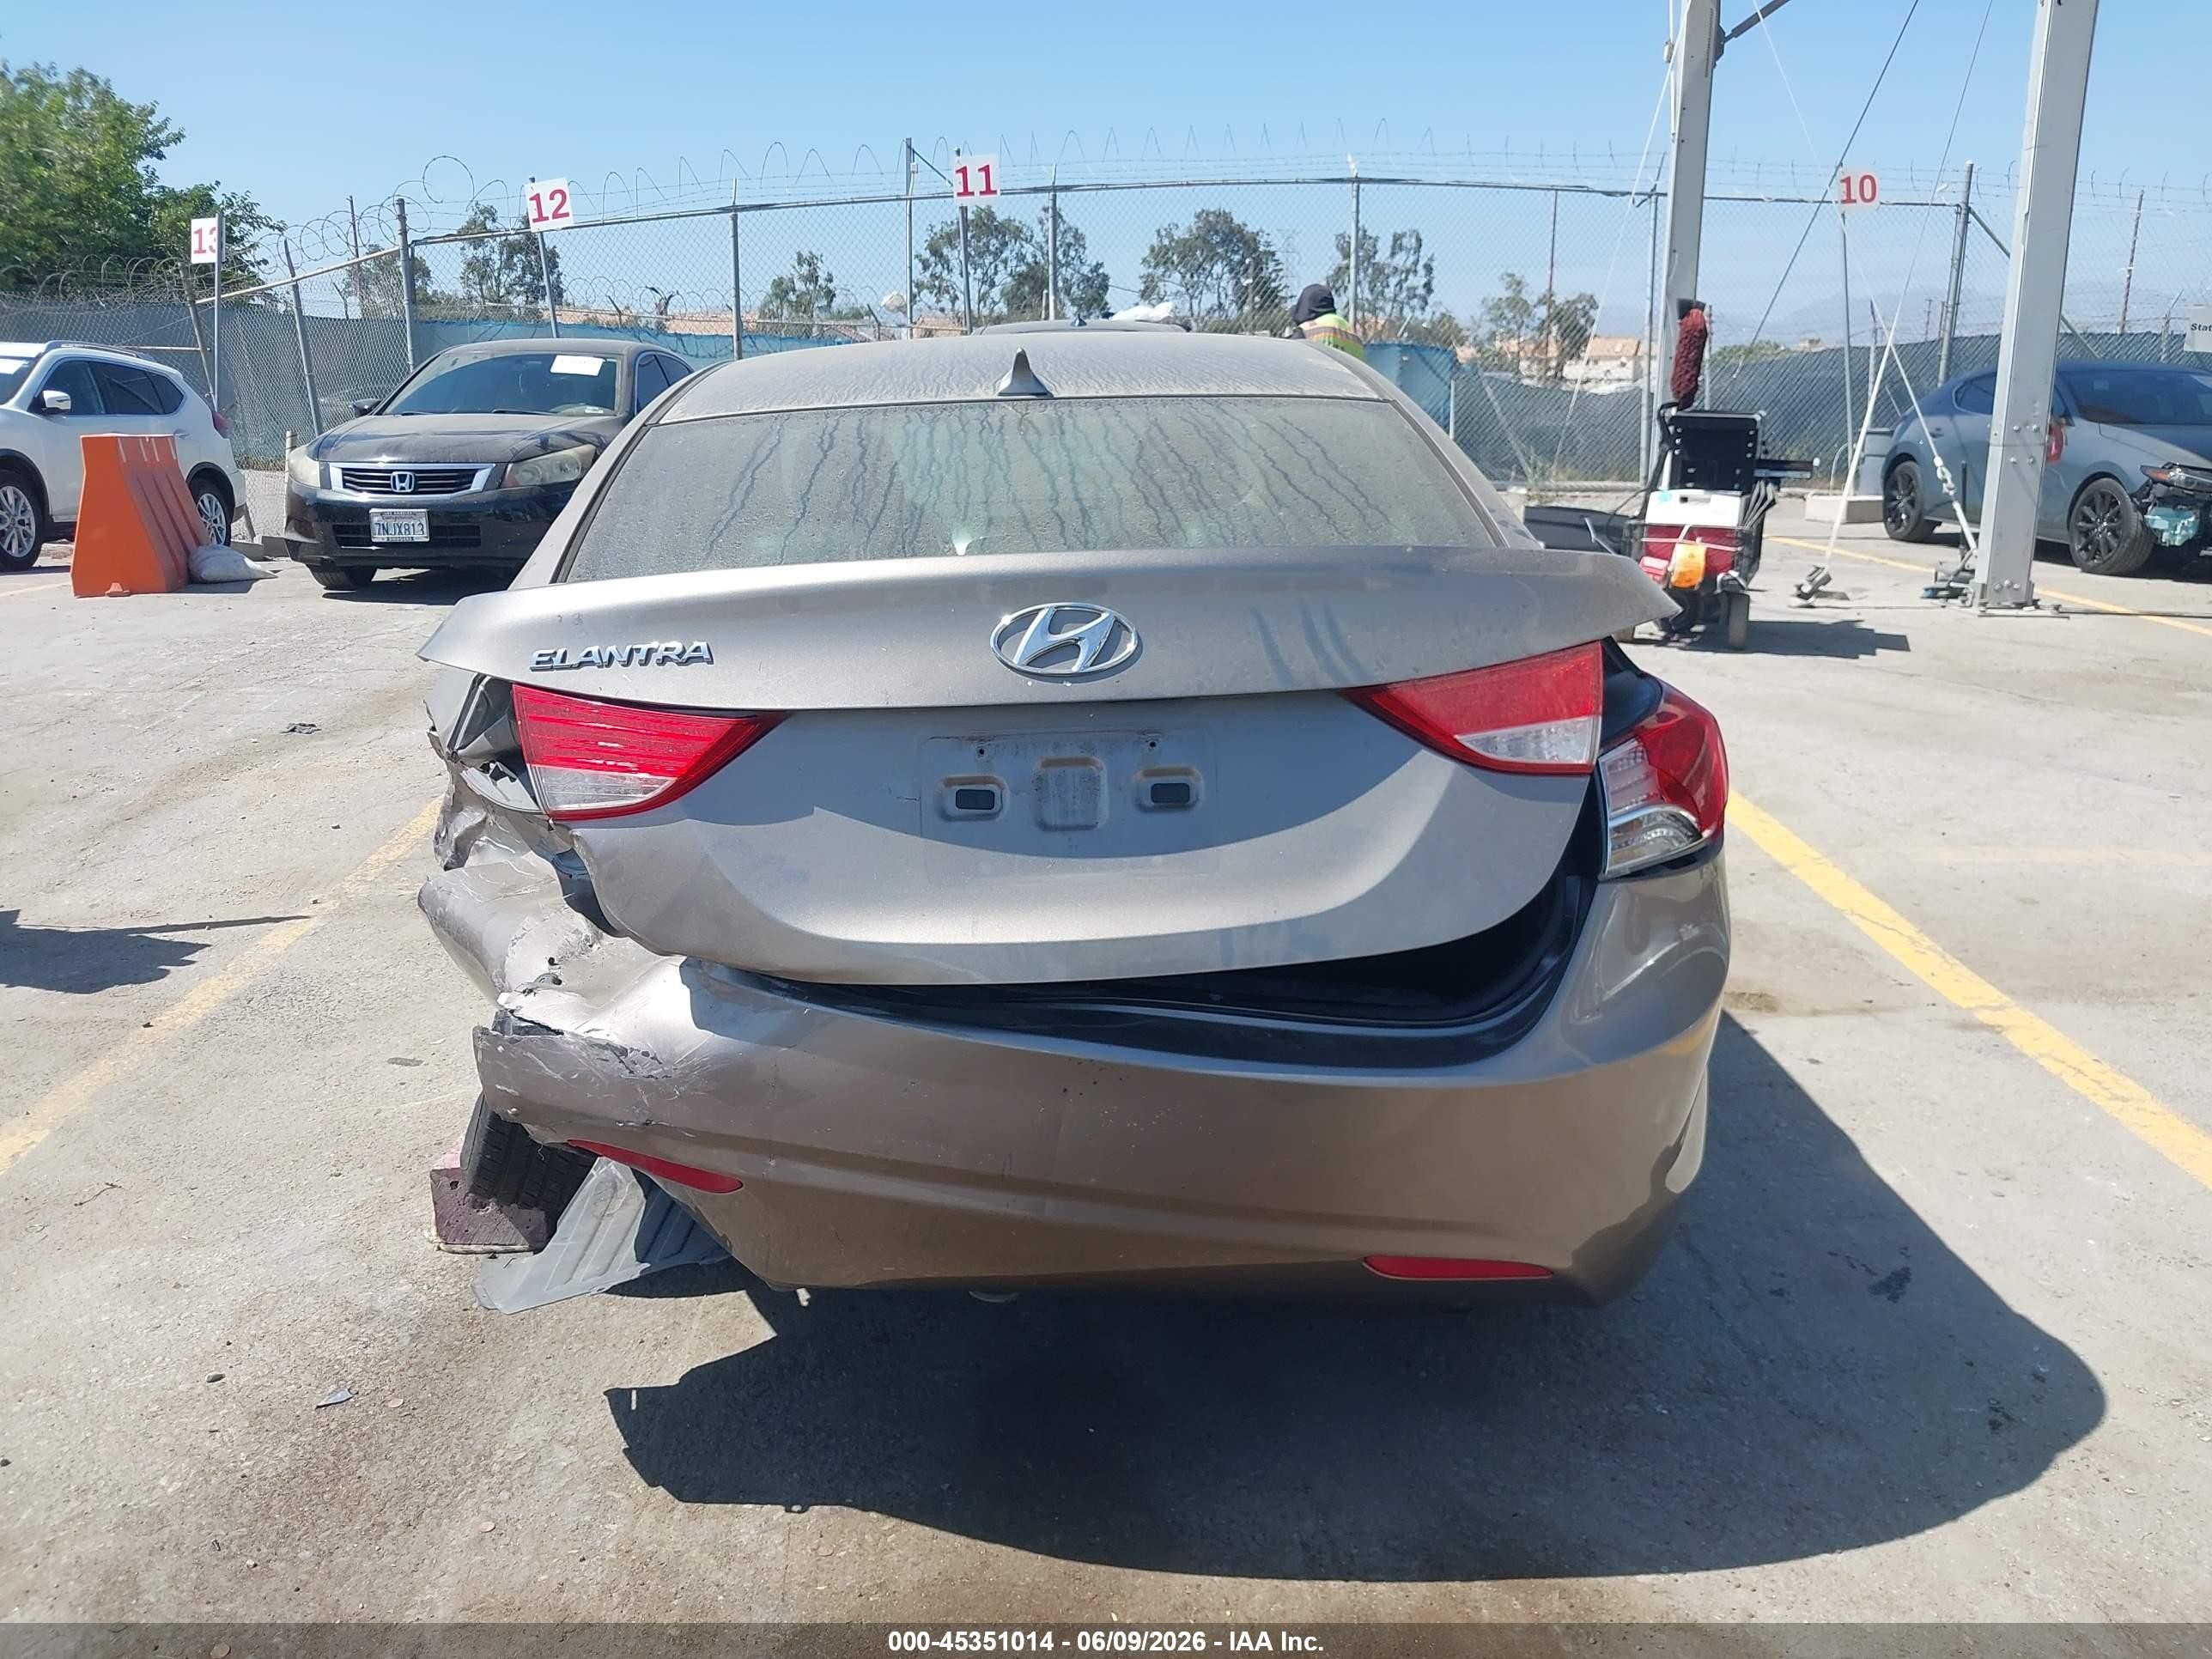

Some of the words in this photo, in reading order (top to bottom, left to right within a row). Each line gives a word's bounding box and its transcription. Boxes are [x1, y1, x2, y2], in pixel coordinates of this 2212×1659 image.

[955, 164, 998, 198] 11
[1839, 174, 1877, 204] 10
[528, 188, 570, 223] 12
[374, 522, 425, 536] 7NJX813
[529, 641, 714, 672] ELANTRA
